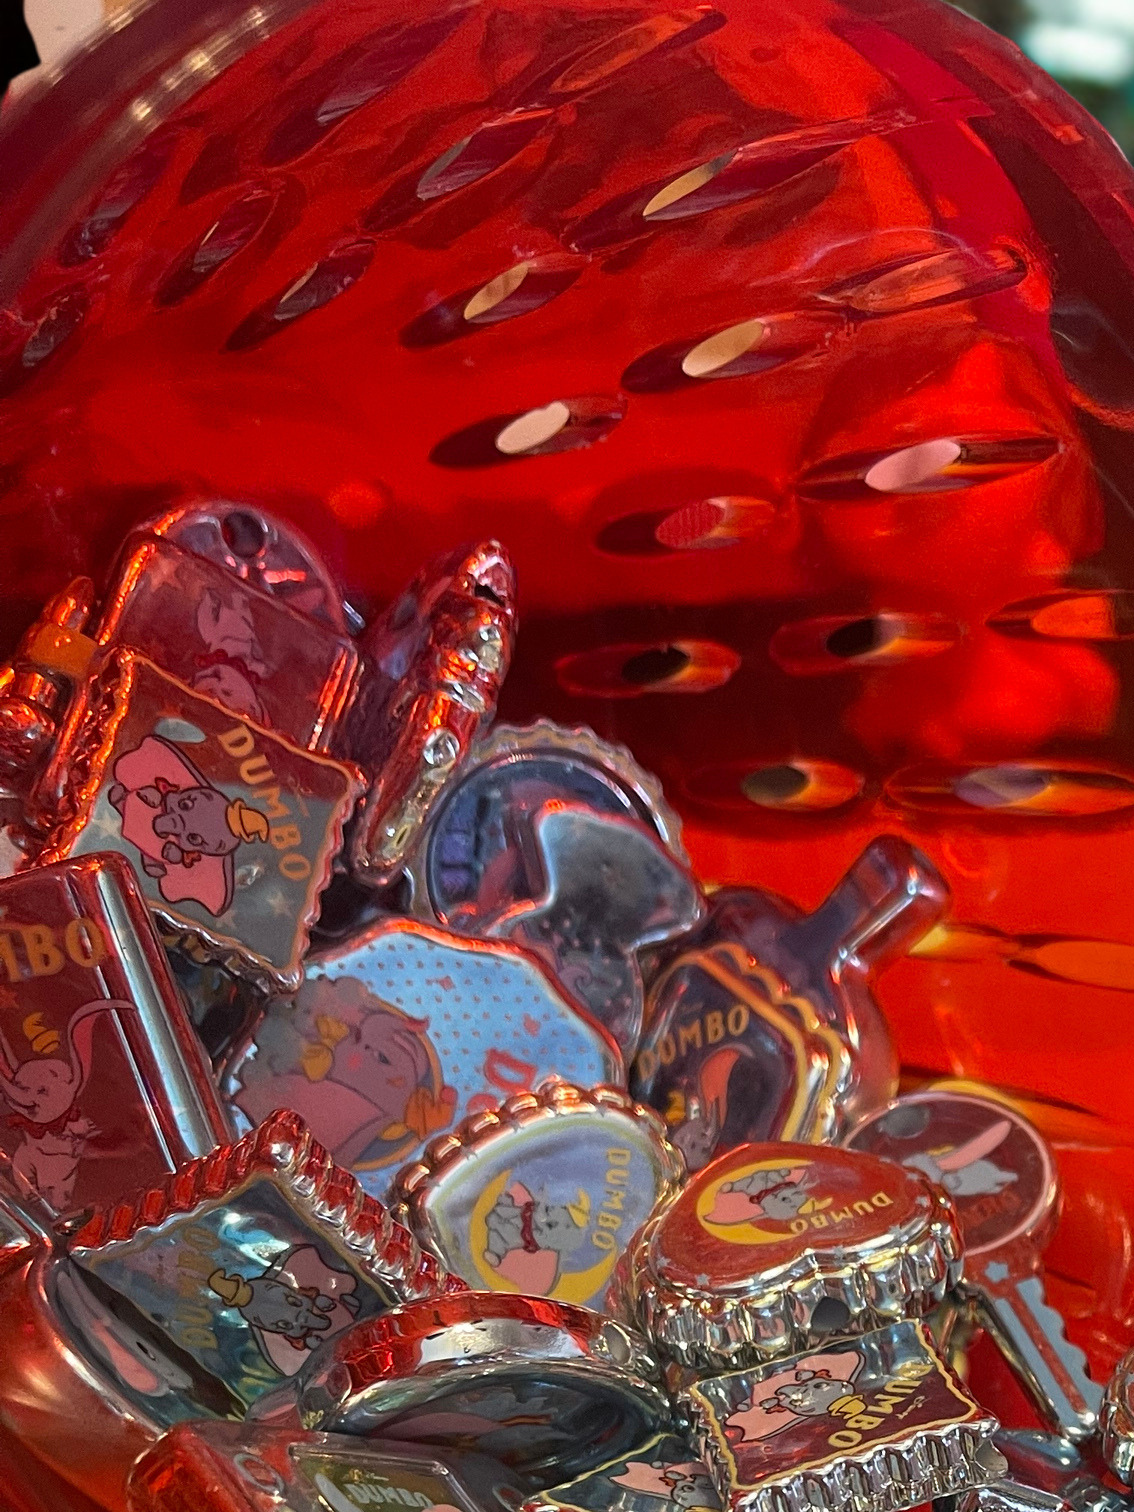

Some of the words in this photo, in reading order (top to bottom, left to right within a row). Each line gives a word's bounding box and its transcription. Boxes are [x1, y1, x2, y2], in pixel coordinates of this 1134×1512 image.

[217, 724, 311, 881] DUMBO
[638, 1004, 750, 1082] DUMBO
[592, 1147, 631, 1250] DUMBO
[790, 1191, 894, 1234] DUMBO
[828, 1360, 934, 1448] DUMBO
